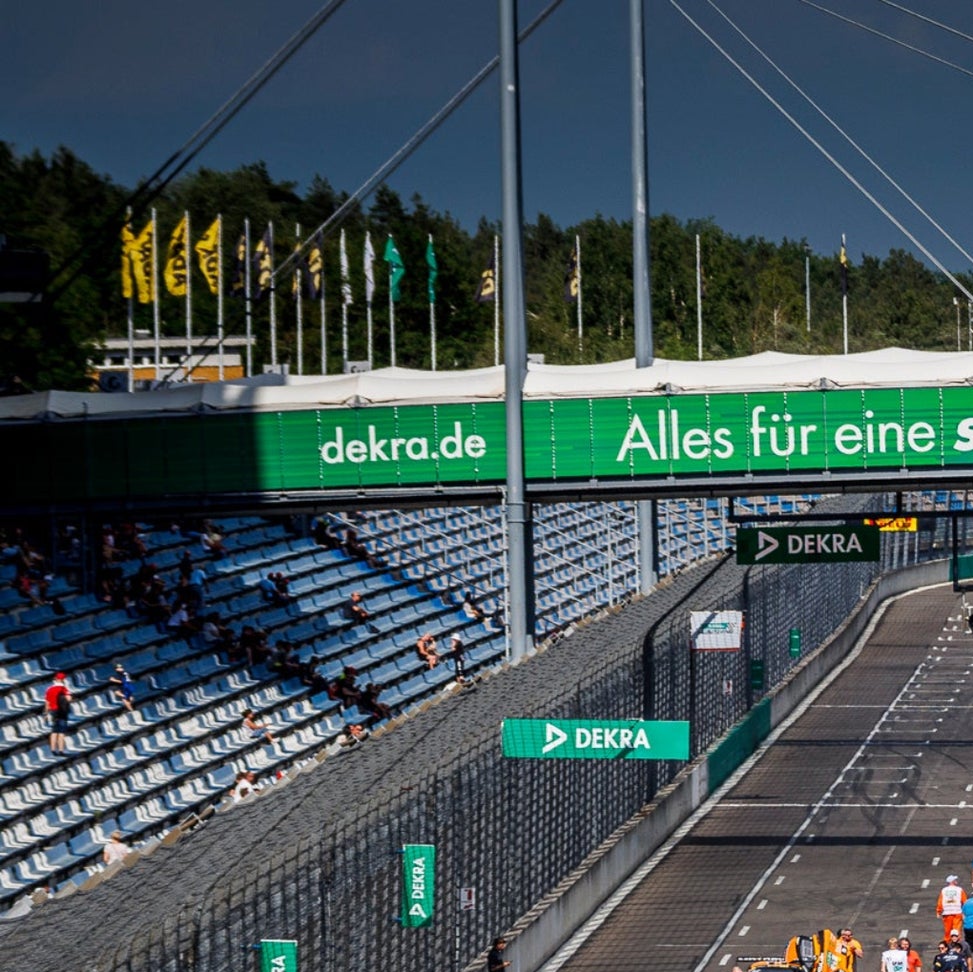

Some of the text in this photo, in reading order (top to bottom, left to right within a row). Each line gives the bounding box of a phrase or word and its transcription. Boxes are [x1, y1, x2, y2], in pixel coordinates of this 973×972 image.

[322, 421, 487, 465] dekra.de
[616, 409, 734, 461] Alles
[750, 406, 818, 457] für
[834, 410, 936, 455] eine
[787, 533, 863, 554] DEKRA
[575, 728, 651, 748] DEKRA
[411, 857, 426, 899] DEKRA
